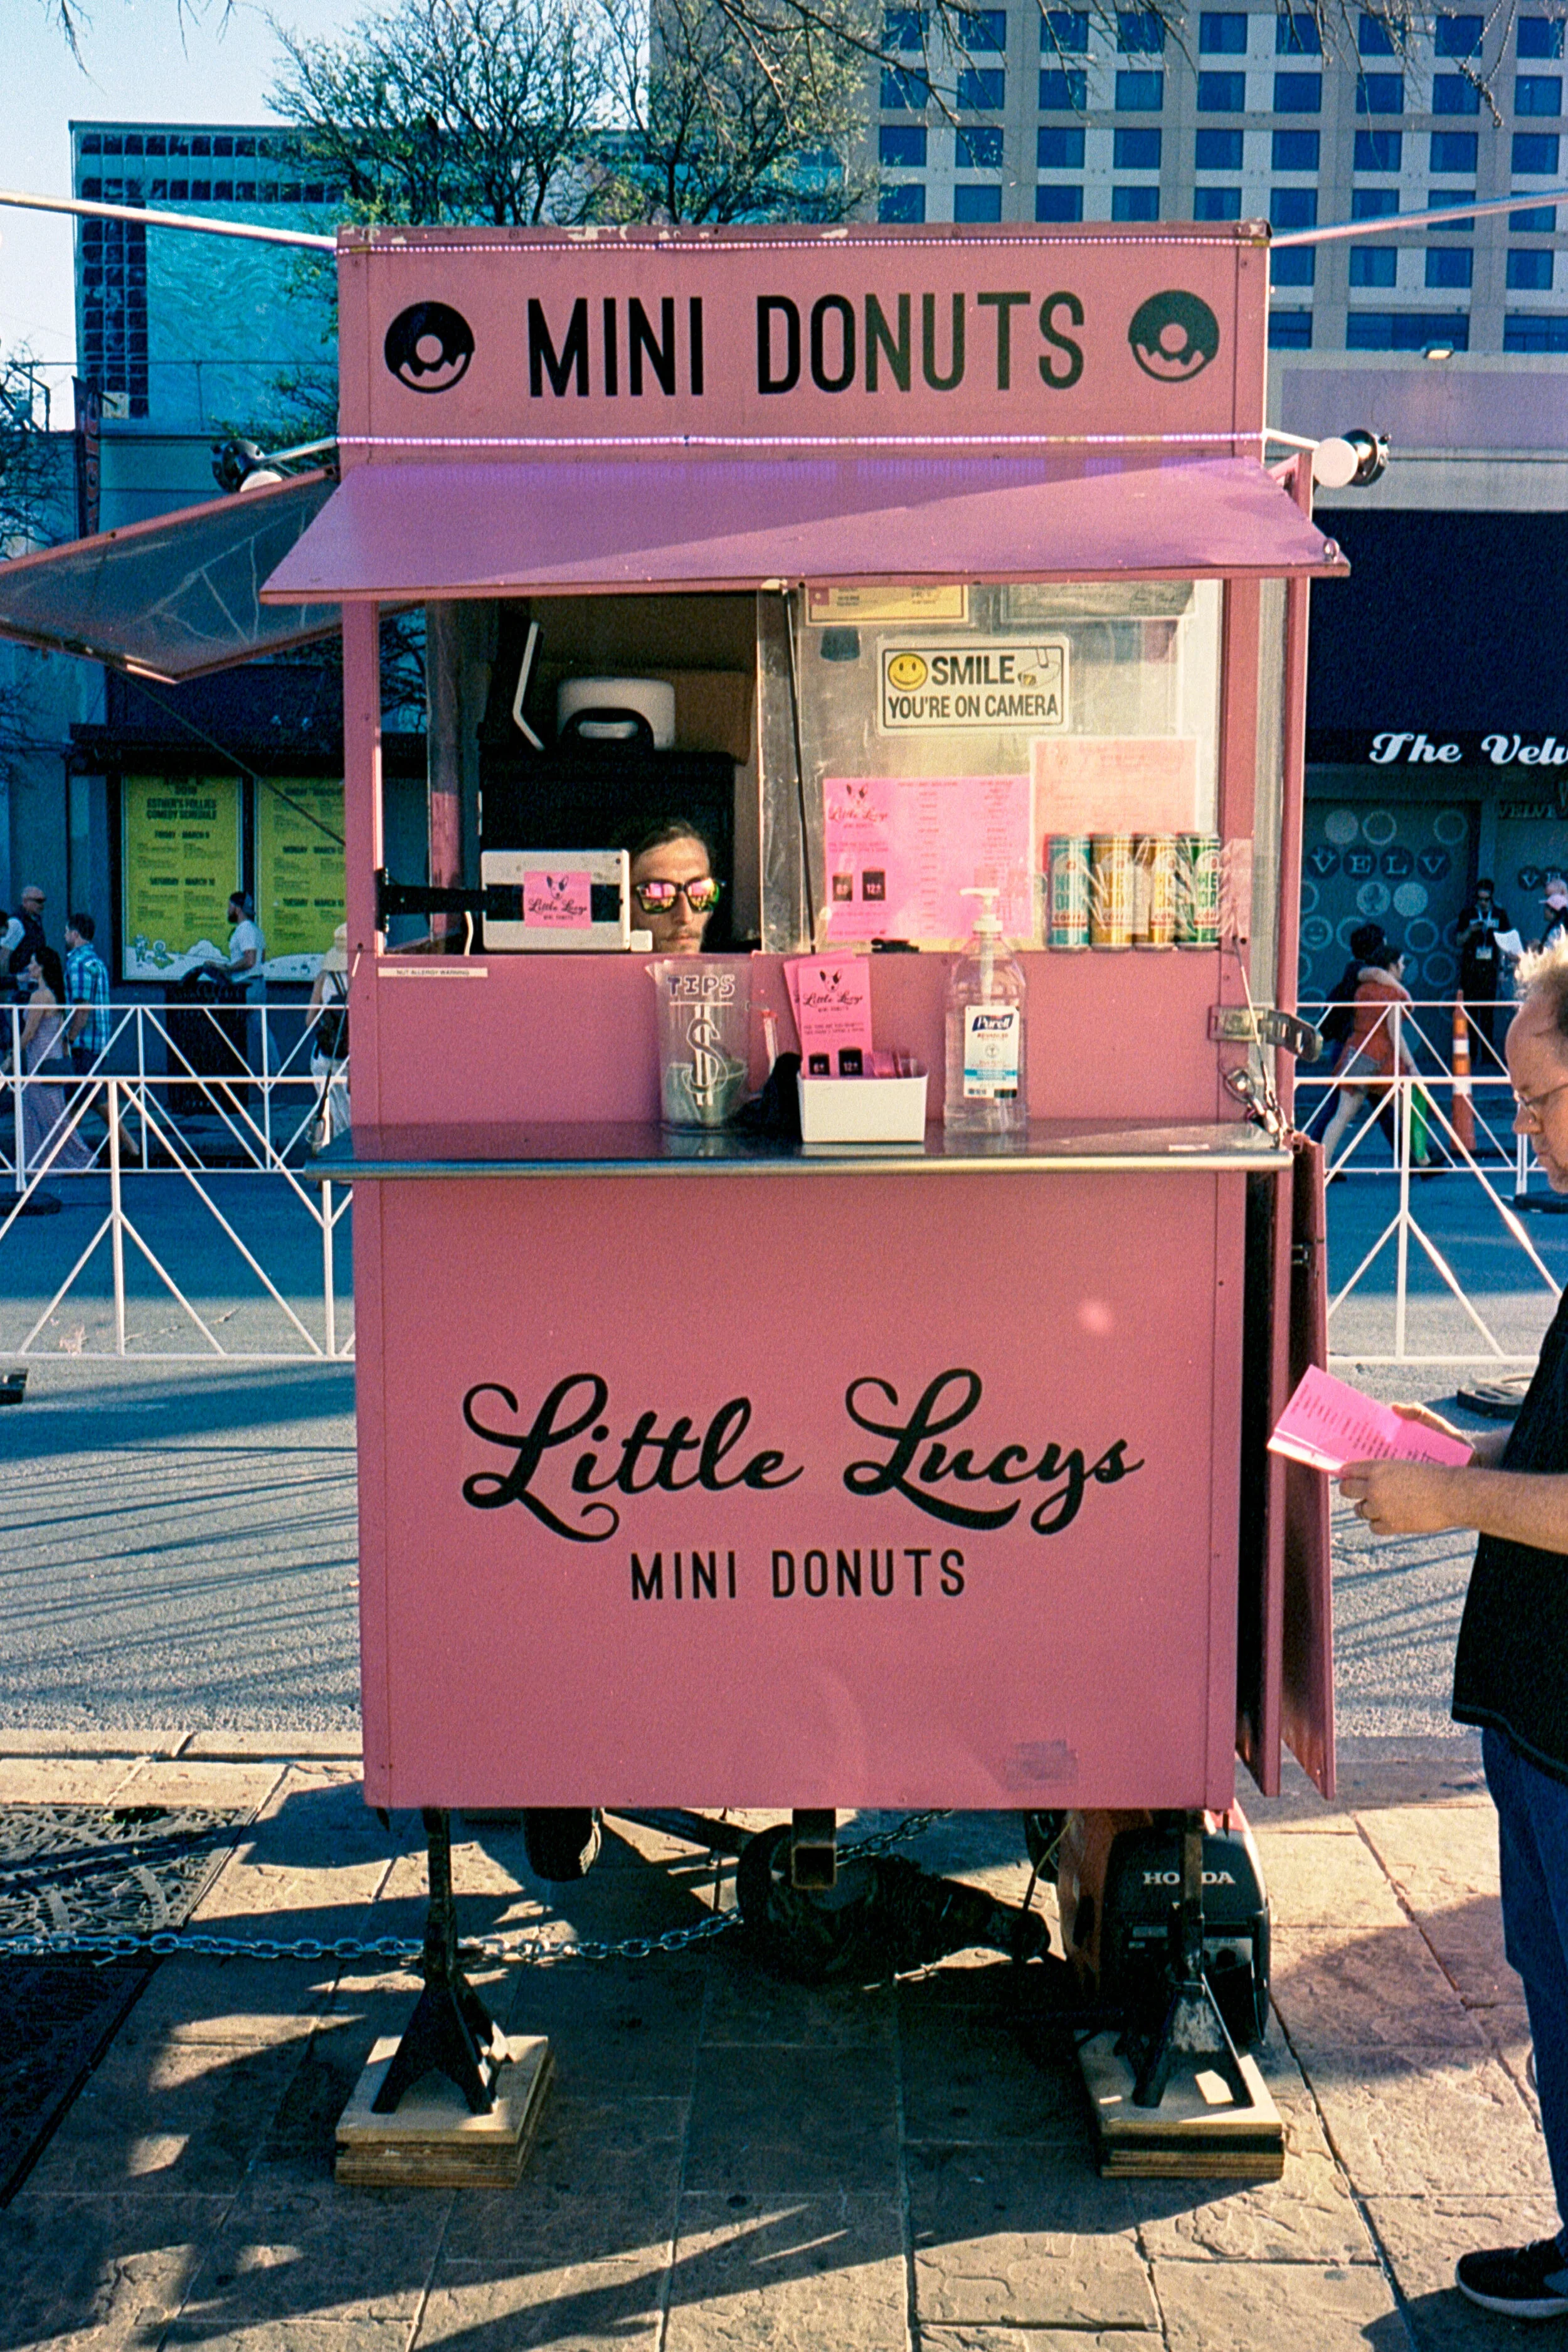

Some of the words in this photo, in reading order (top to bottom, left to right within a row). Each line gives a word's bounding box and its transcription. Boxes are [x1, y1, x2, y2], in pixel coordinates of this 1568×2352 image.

[527, 296, 704, 398] MINI
[756, 292, 1085, 395] DONUTS
[931, 655, 1015, 685] SMILE
[887, 696, 950, 719] YOU'RE
[955, 695, 980, 718] ON
[985, 694, 1058, 718] CAMERA
[1369, 732, 1463, 764] The
[528, 898, 558, 914] Little
[667, 974, 735, 997] TIPS
[803, 992, 832, 1008] Little
[976, 1015, 1012, 1030] Purell
[462, 1373, 805, 1543] Little
[842, 1369, 1145, 1536] Lucys
[630, 1552, 736, 1601] MINI
[772, 1549, 965, 1598] DONUTS
[1142, 1871, 1236, 1885] HODA
